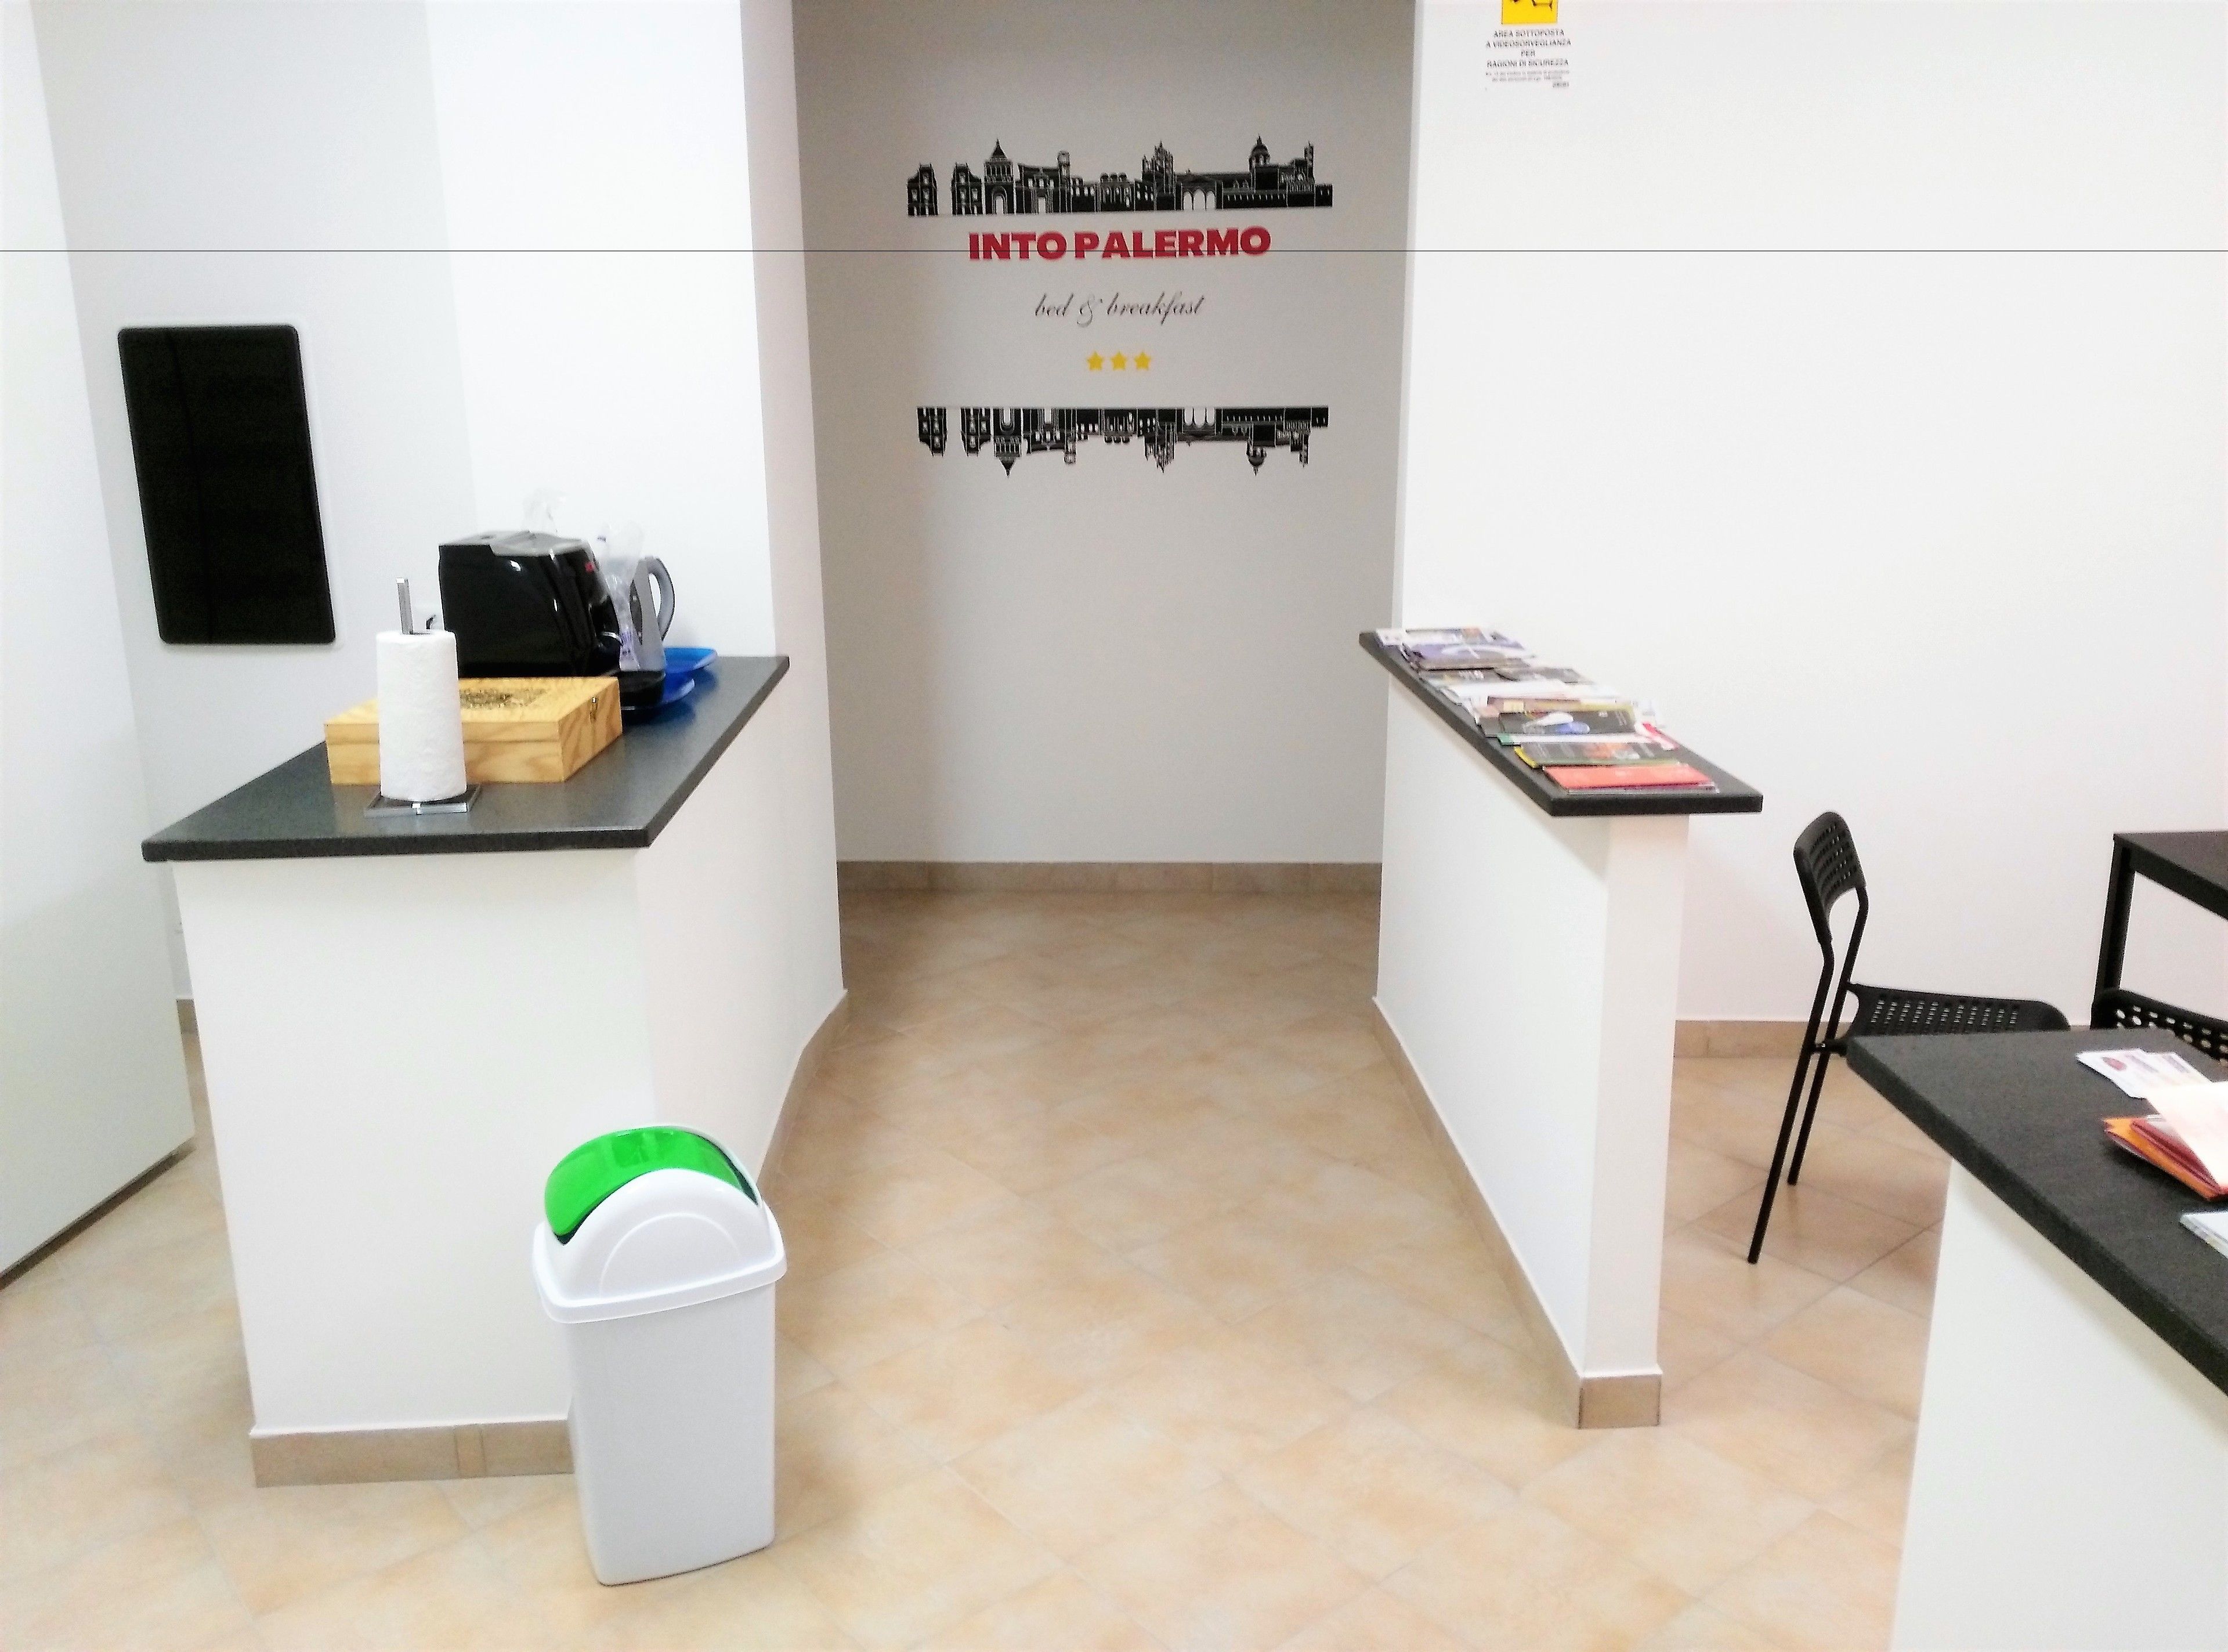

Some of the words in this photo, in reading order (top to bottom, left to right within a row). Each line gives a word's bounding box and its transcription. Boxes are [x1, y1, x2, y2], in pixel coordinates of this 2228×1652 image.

[1493, 39, 1571, 48] VIDEOSORVEGLIANZA
[1486, 60, 1517, 68] RAGIONI
[968, 232, 1067, 260] INTO
[1075, 226, 1272, 259] PALERMO
[1035, 292, 1074, 317] bed
[1076, 295, 1102, 328] &
[1106, 291, 1205, 325] breakfast
